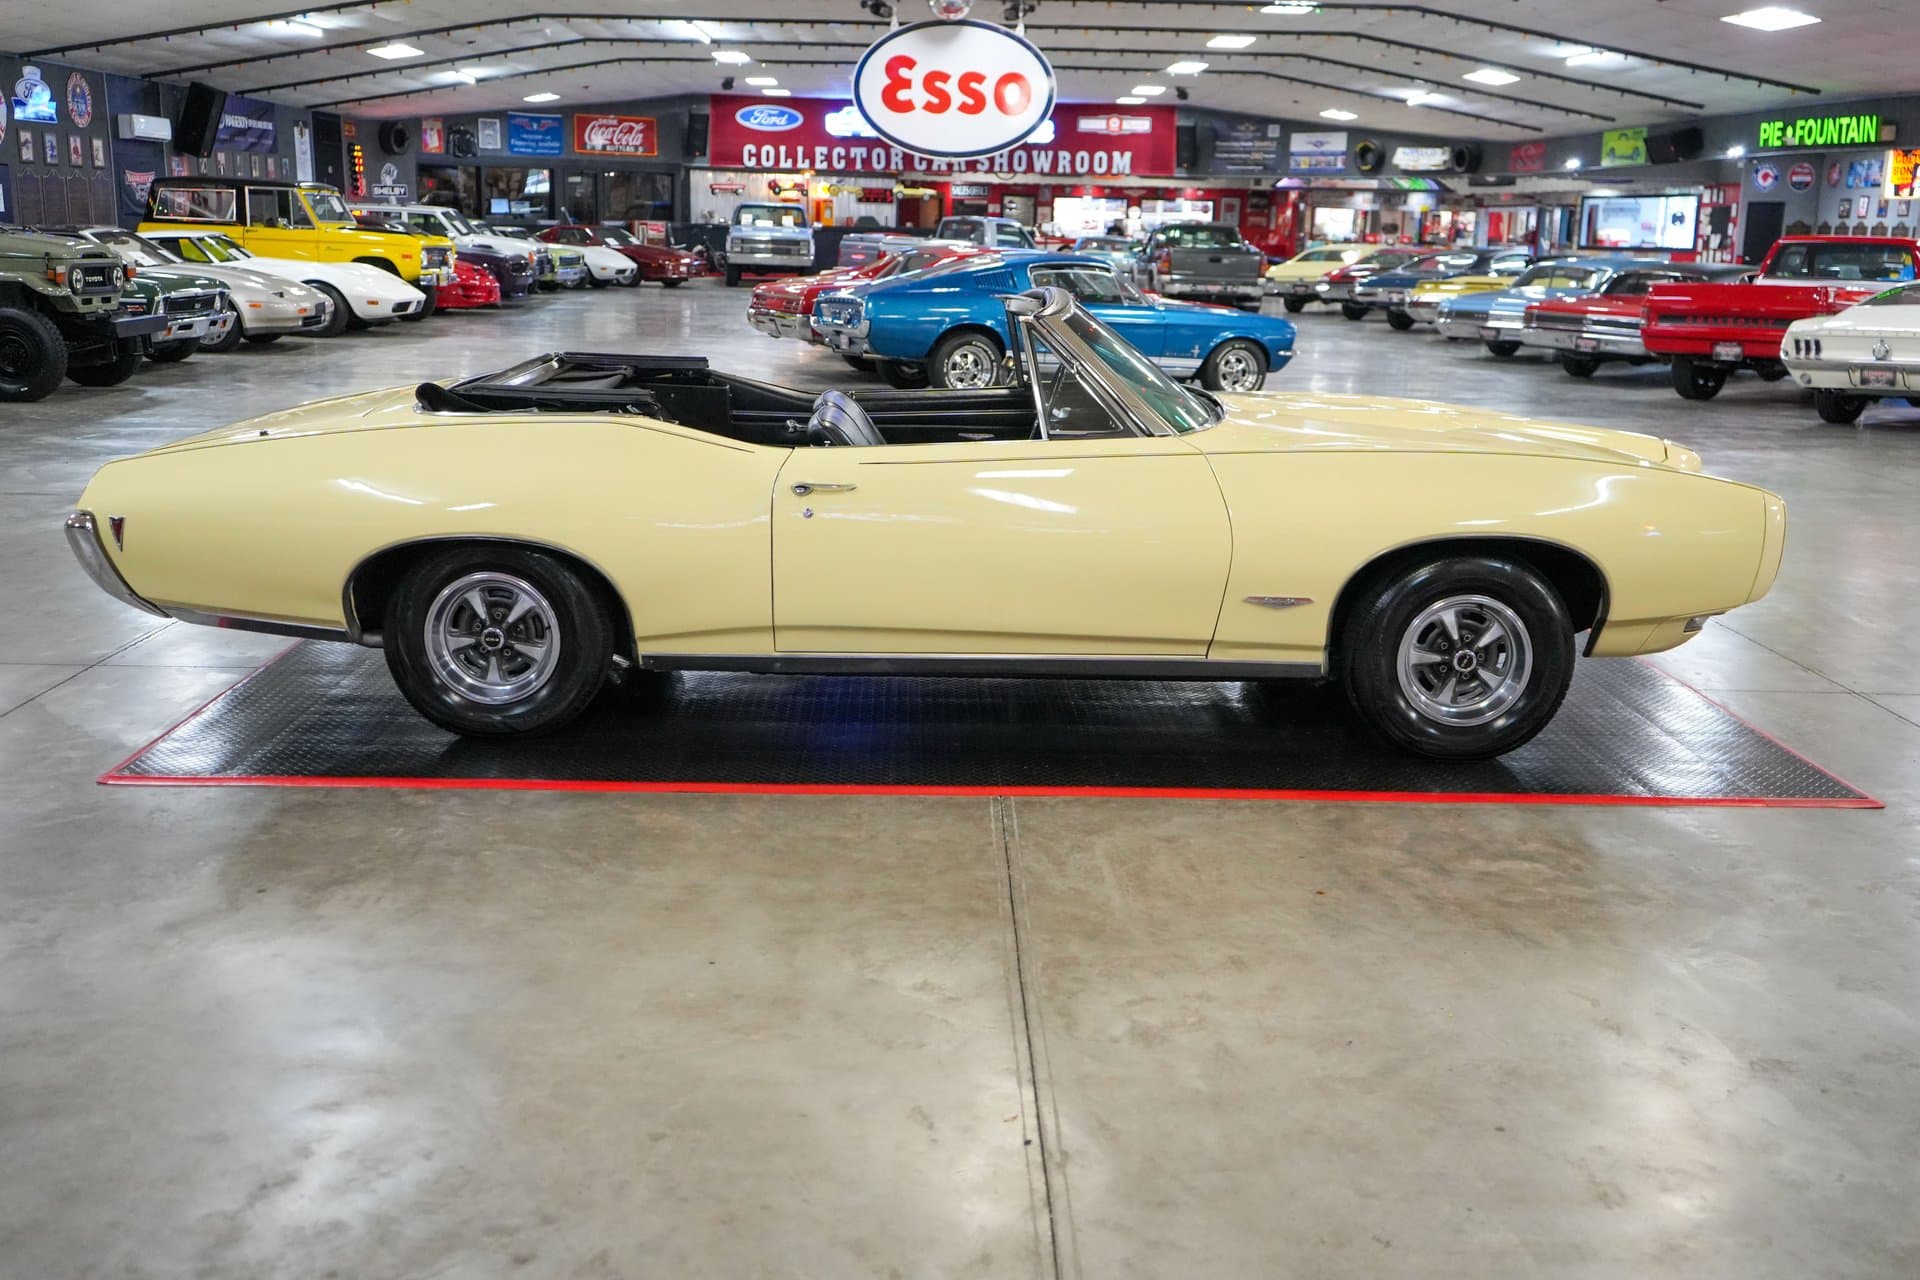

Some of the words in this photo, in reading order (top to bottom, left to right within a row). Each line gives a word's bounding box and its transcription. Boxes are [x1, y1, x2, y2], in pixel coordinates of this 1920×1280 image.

[750, 109, 788, 126] Ford
[584, 120, 647, 146] Coca-Cola
[1759, 120, 1784, 147] PIE
[1795, 114, 1878, 146] FOUNTAIN
[742, 143, 904, 171] COLLECTOR
[976, 150, 1133, 175] SHOWROOM
[373, 186, 406, 195] SHELBY
[85, 275, 103, 283] TOYOTA
[1685, 315, 1776, 327] CHEVROLET
